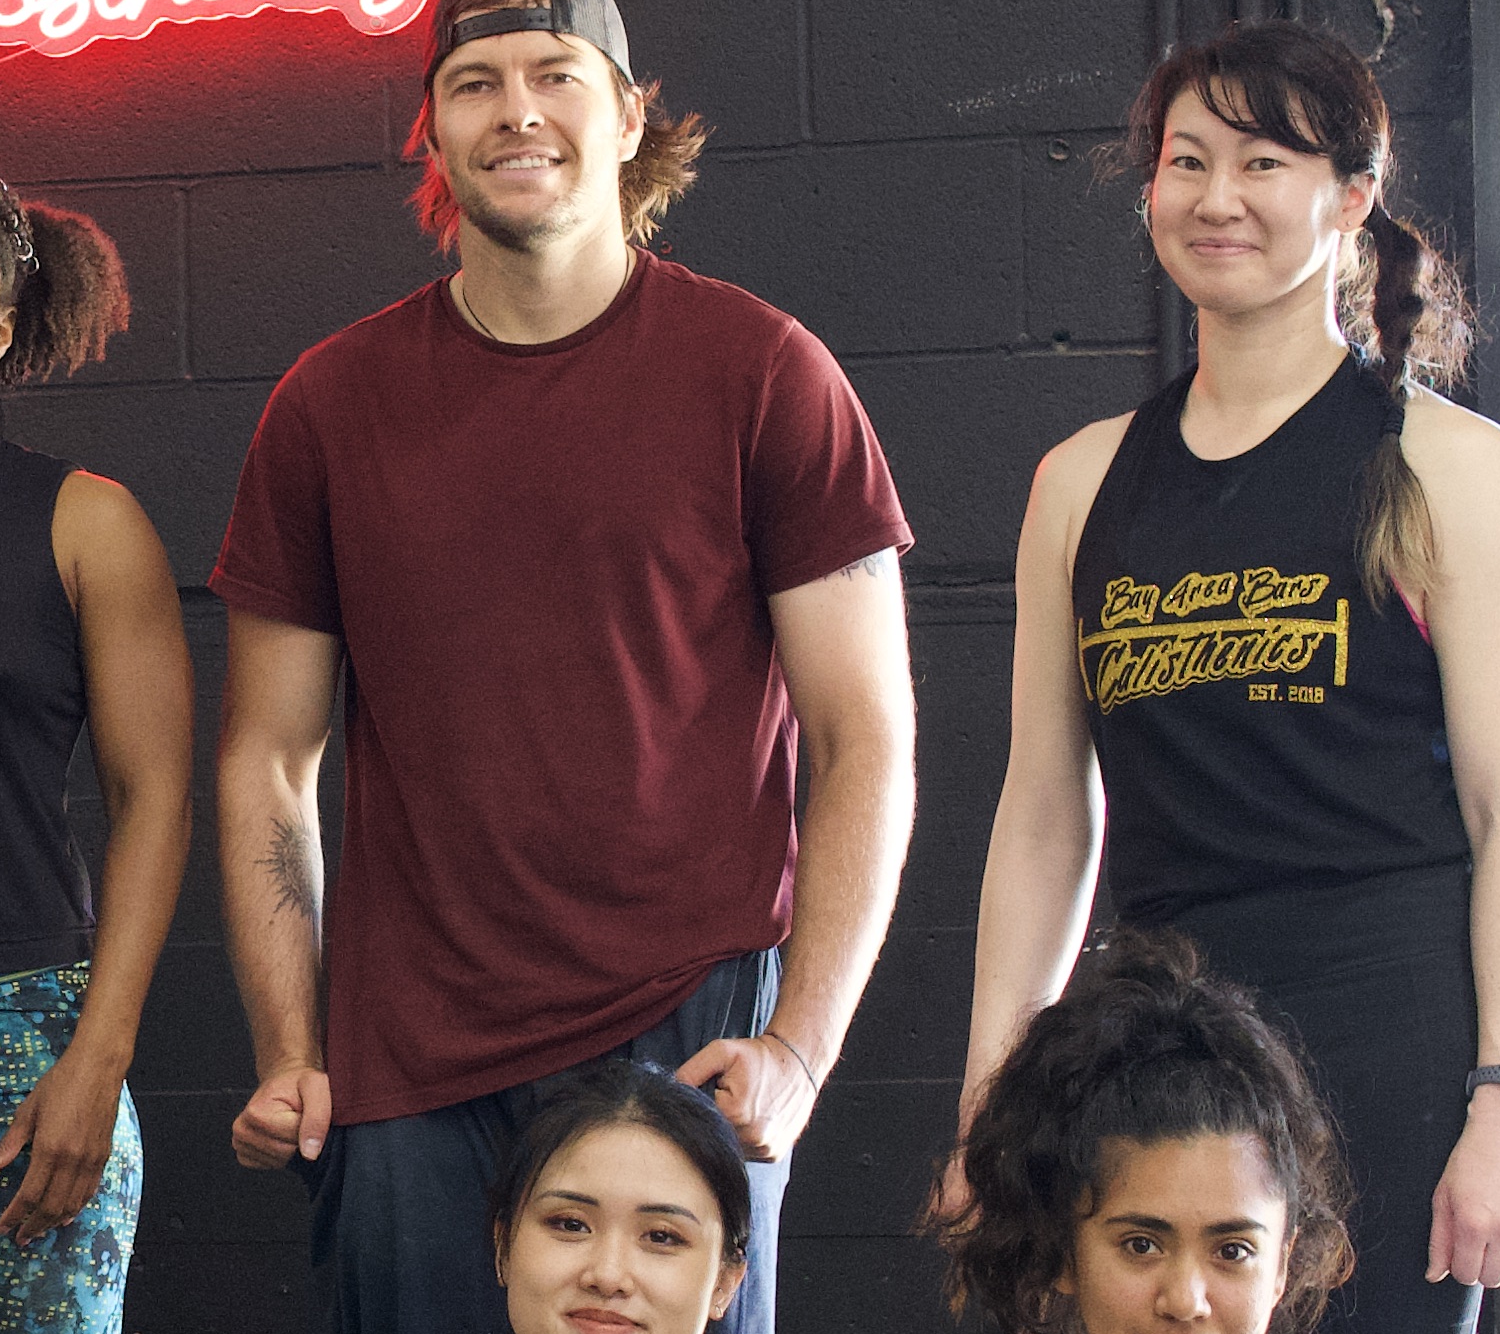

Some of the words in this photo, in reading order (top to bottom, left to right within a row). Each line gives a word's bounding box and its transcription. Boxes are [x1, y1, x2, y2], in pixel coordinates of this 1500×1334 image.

[1103, 578, 1159, 626] Bay
[1163, 572, 1238, 616] Area
[1240, 567, 1329, 617] Bars
[1248, 683, 1284, 702] EST.
[1287, 685, 1325, 704] 2018
